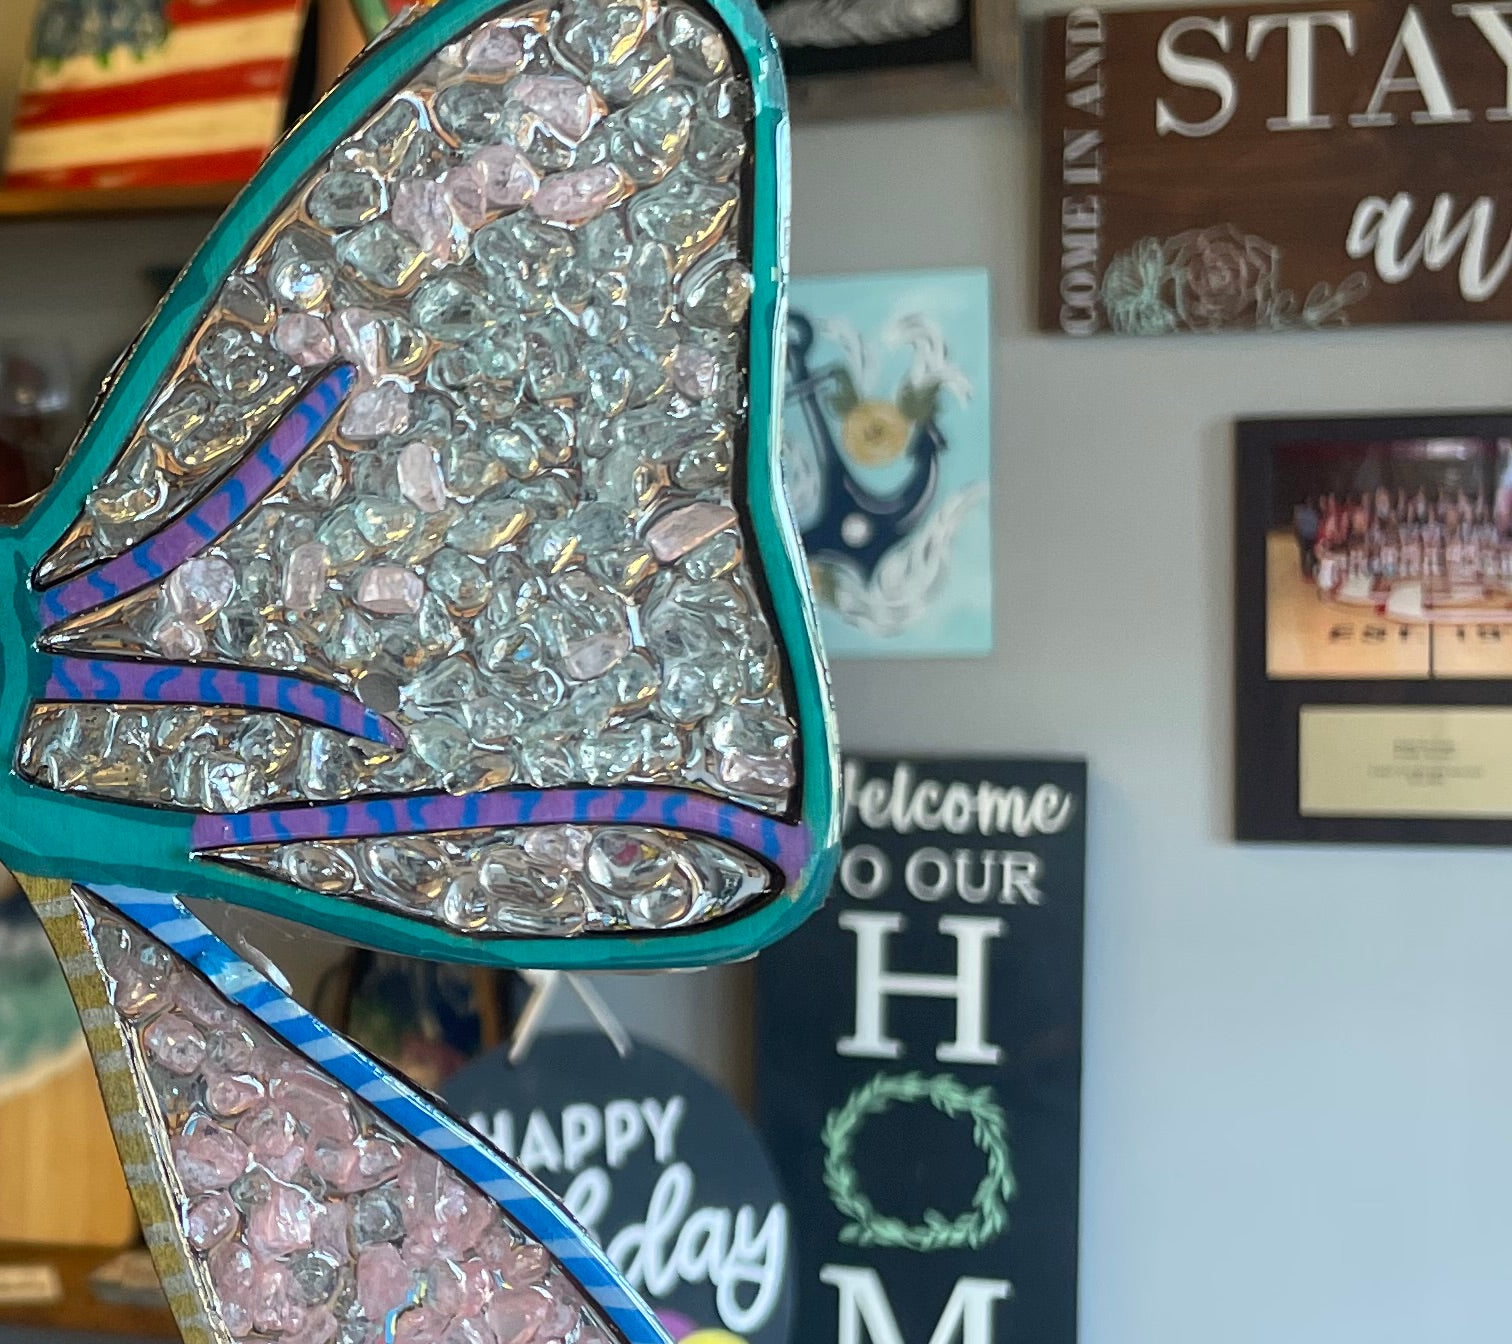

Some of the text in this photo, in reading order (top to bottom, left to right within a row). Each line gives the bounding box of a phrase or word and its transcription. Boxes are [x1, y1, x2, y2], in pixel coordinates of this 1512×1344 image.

[1059, 6, 1106, 336] COME IN AND
[843, 759, 1073, 838] elcome
[904, 845, 1046, 906] OUR
